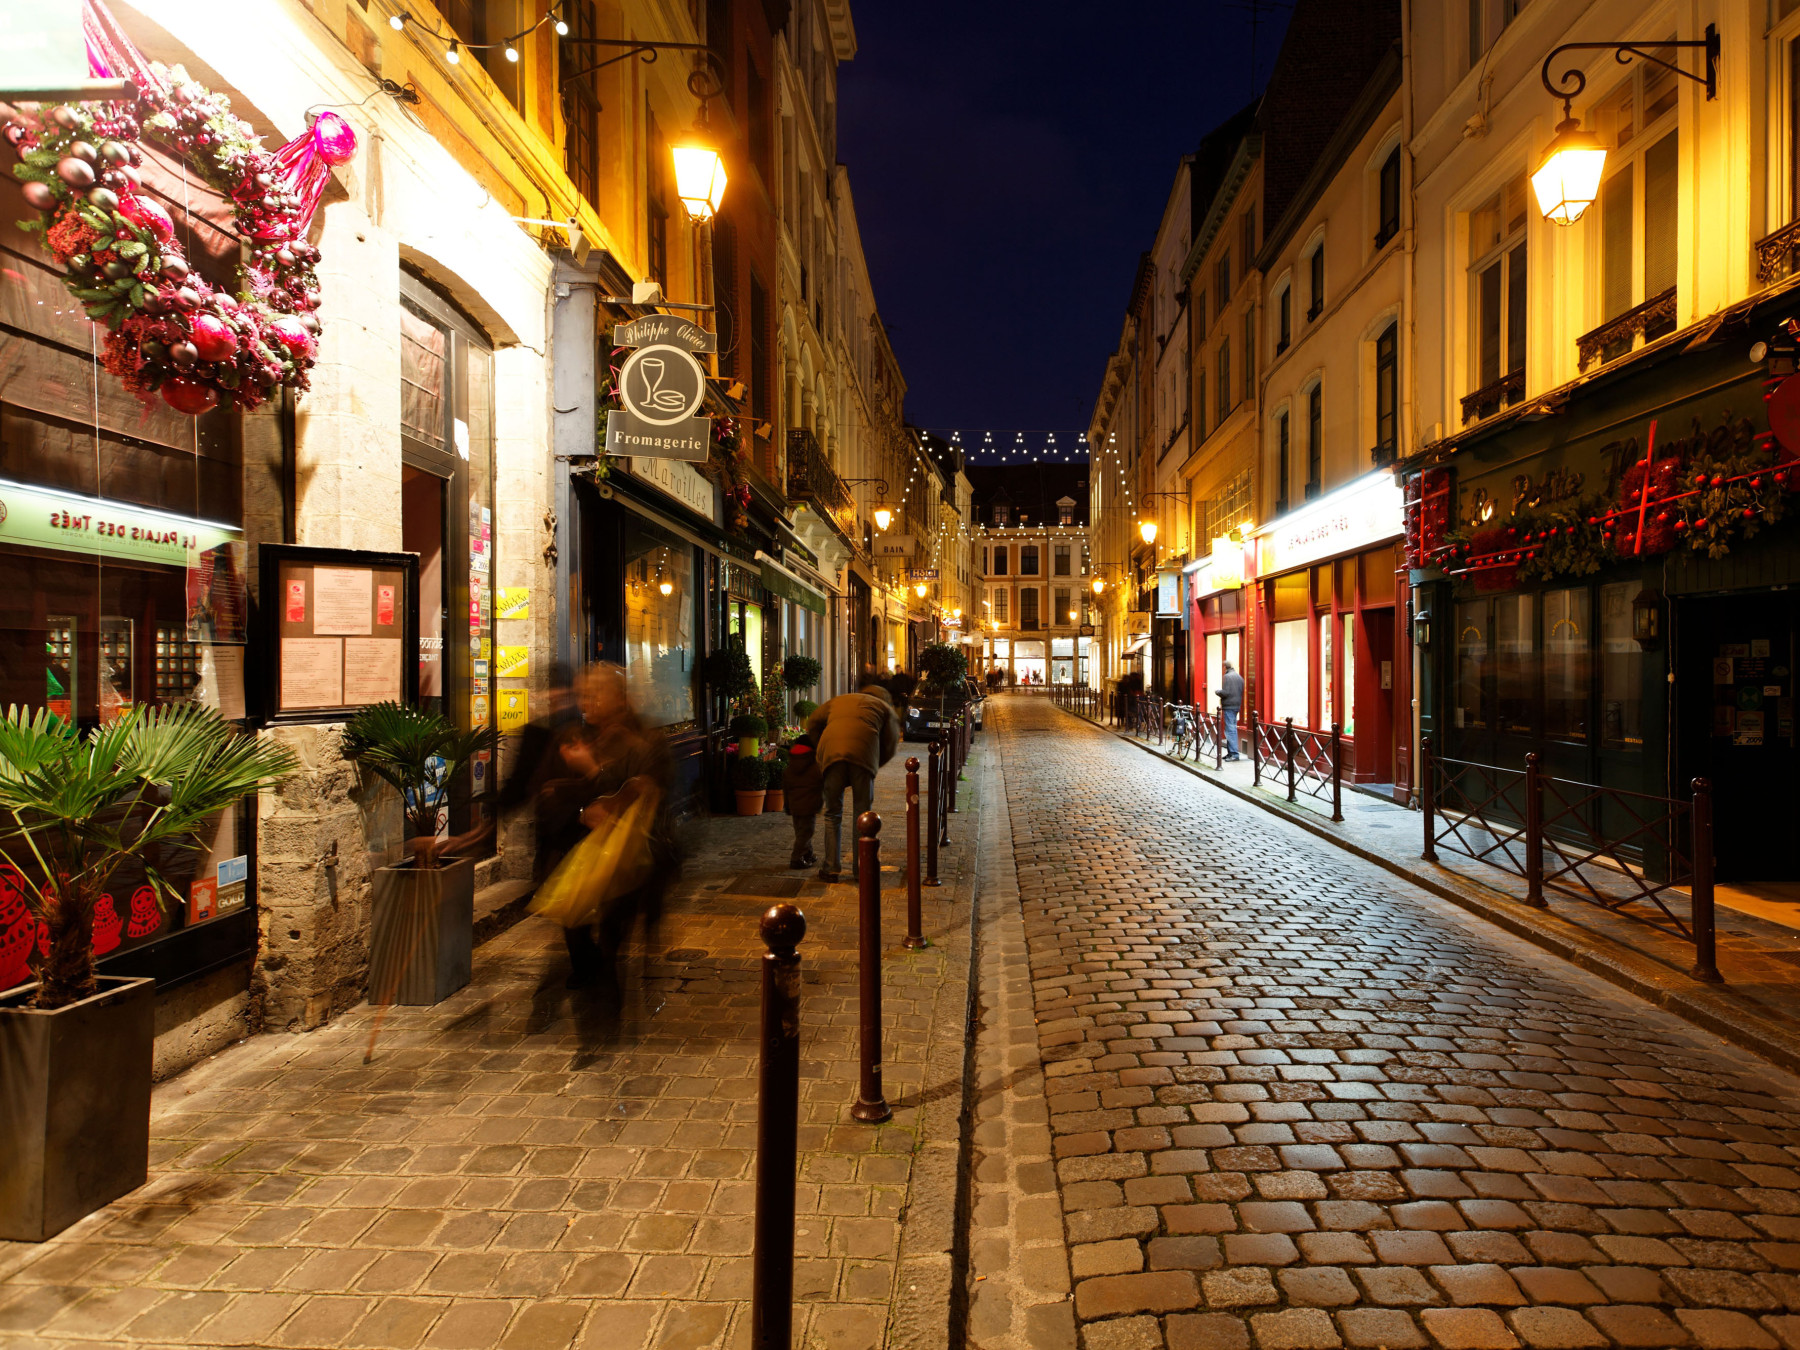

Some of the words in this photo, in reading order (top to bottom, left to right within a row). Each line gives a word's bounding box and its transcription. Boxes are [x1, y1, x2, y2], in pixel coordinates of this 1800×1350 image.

[625, 322, 670, 345] Philippe
[676, 324, 706, 349] Olivier
[614, 431, 702, 450] Fromagerie
[642, 457, 707, 511] Maroilles
[912, 569, 936, 577] Hôtel
[501, 711, 523, 720] 2007
[217, 891, 245, 909] GOLD
